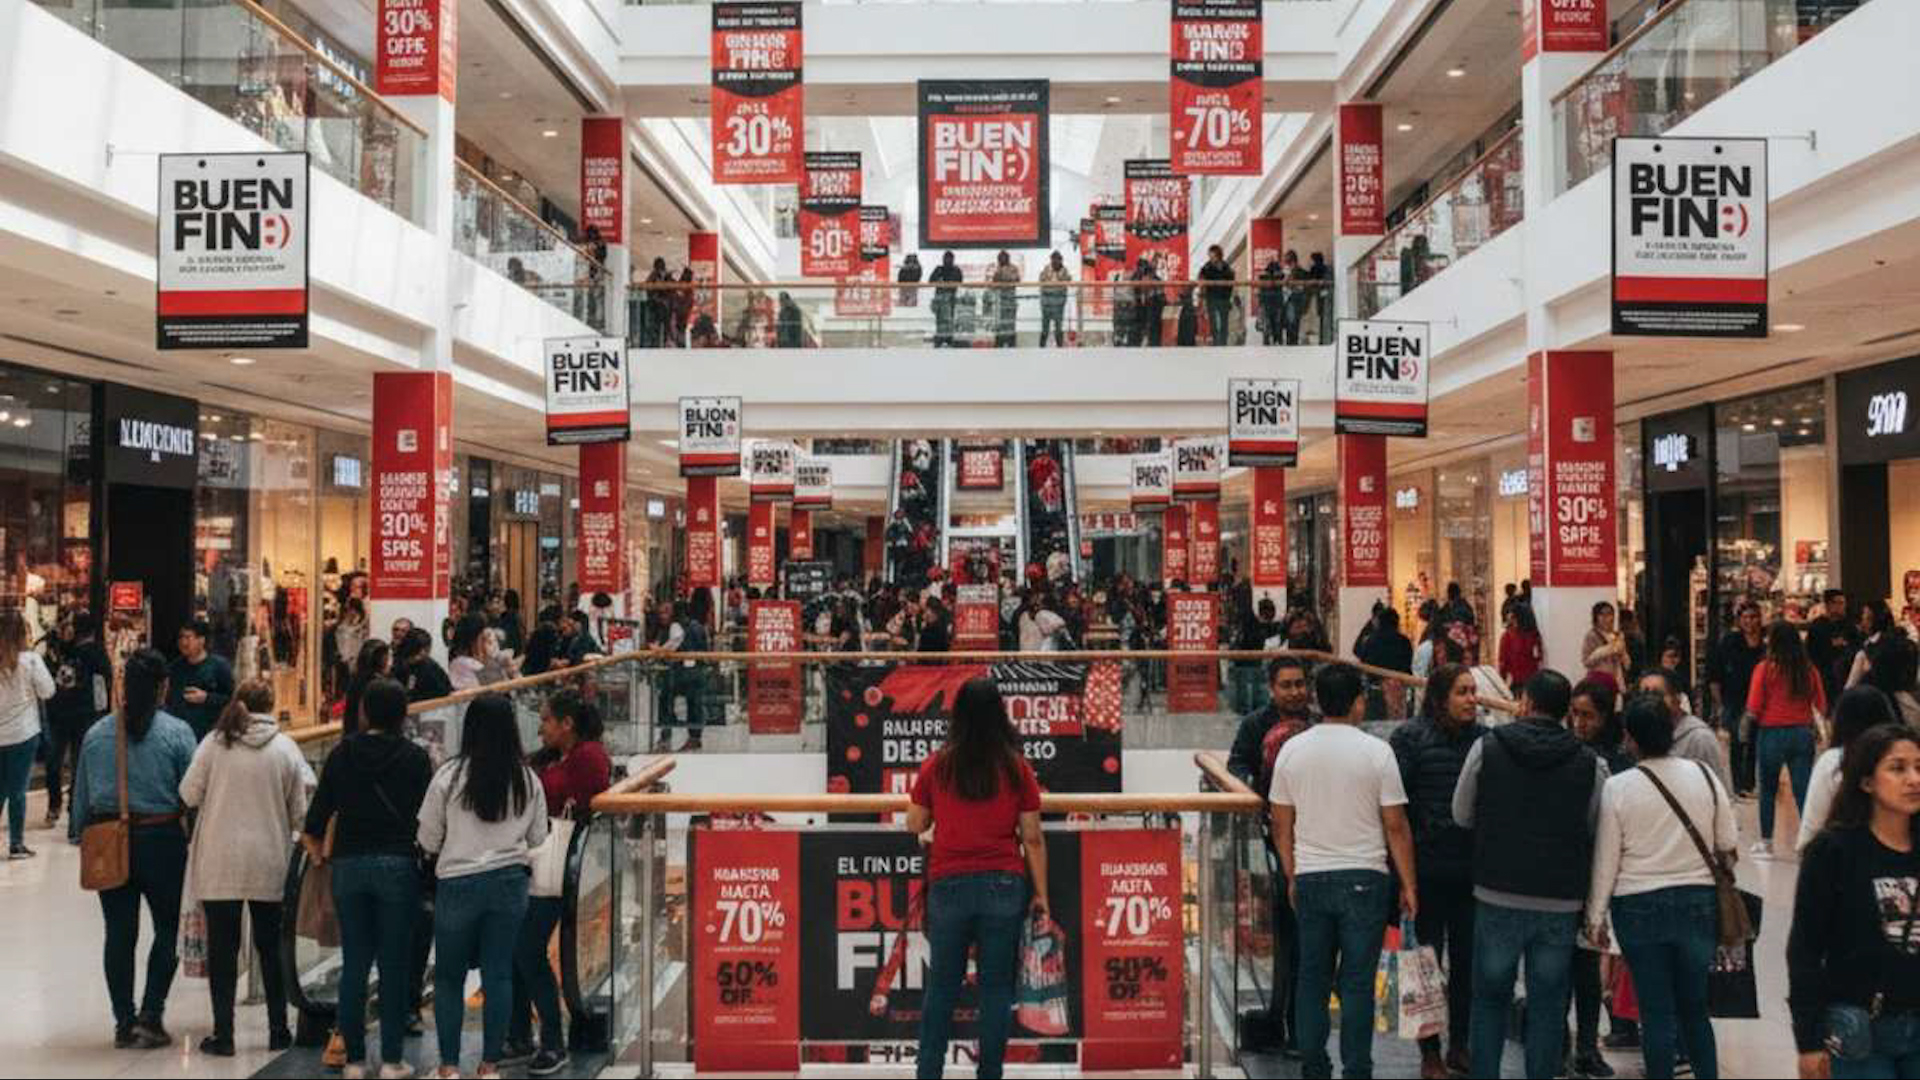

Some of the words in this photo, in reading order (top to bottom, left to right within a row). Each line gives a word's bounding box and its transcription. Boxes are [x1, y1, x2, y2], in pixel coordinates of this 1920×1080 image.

[934, 121, 1031, 150] BUEN
[1630, 163, 1752, 197] BUEN
[174, 178, 293, 211] BUEN
[1347, 335, 1420, 357] BUEN
[552, 352, 619, 370] BUEN
[380, 512, 428, 537] 30%
[837, 856, 859, 873] EL
[896, 856, 922, 873] DE
